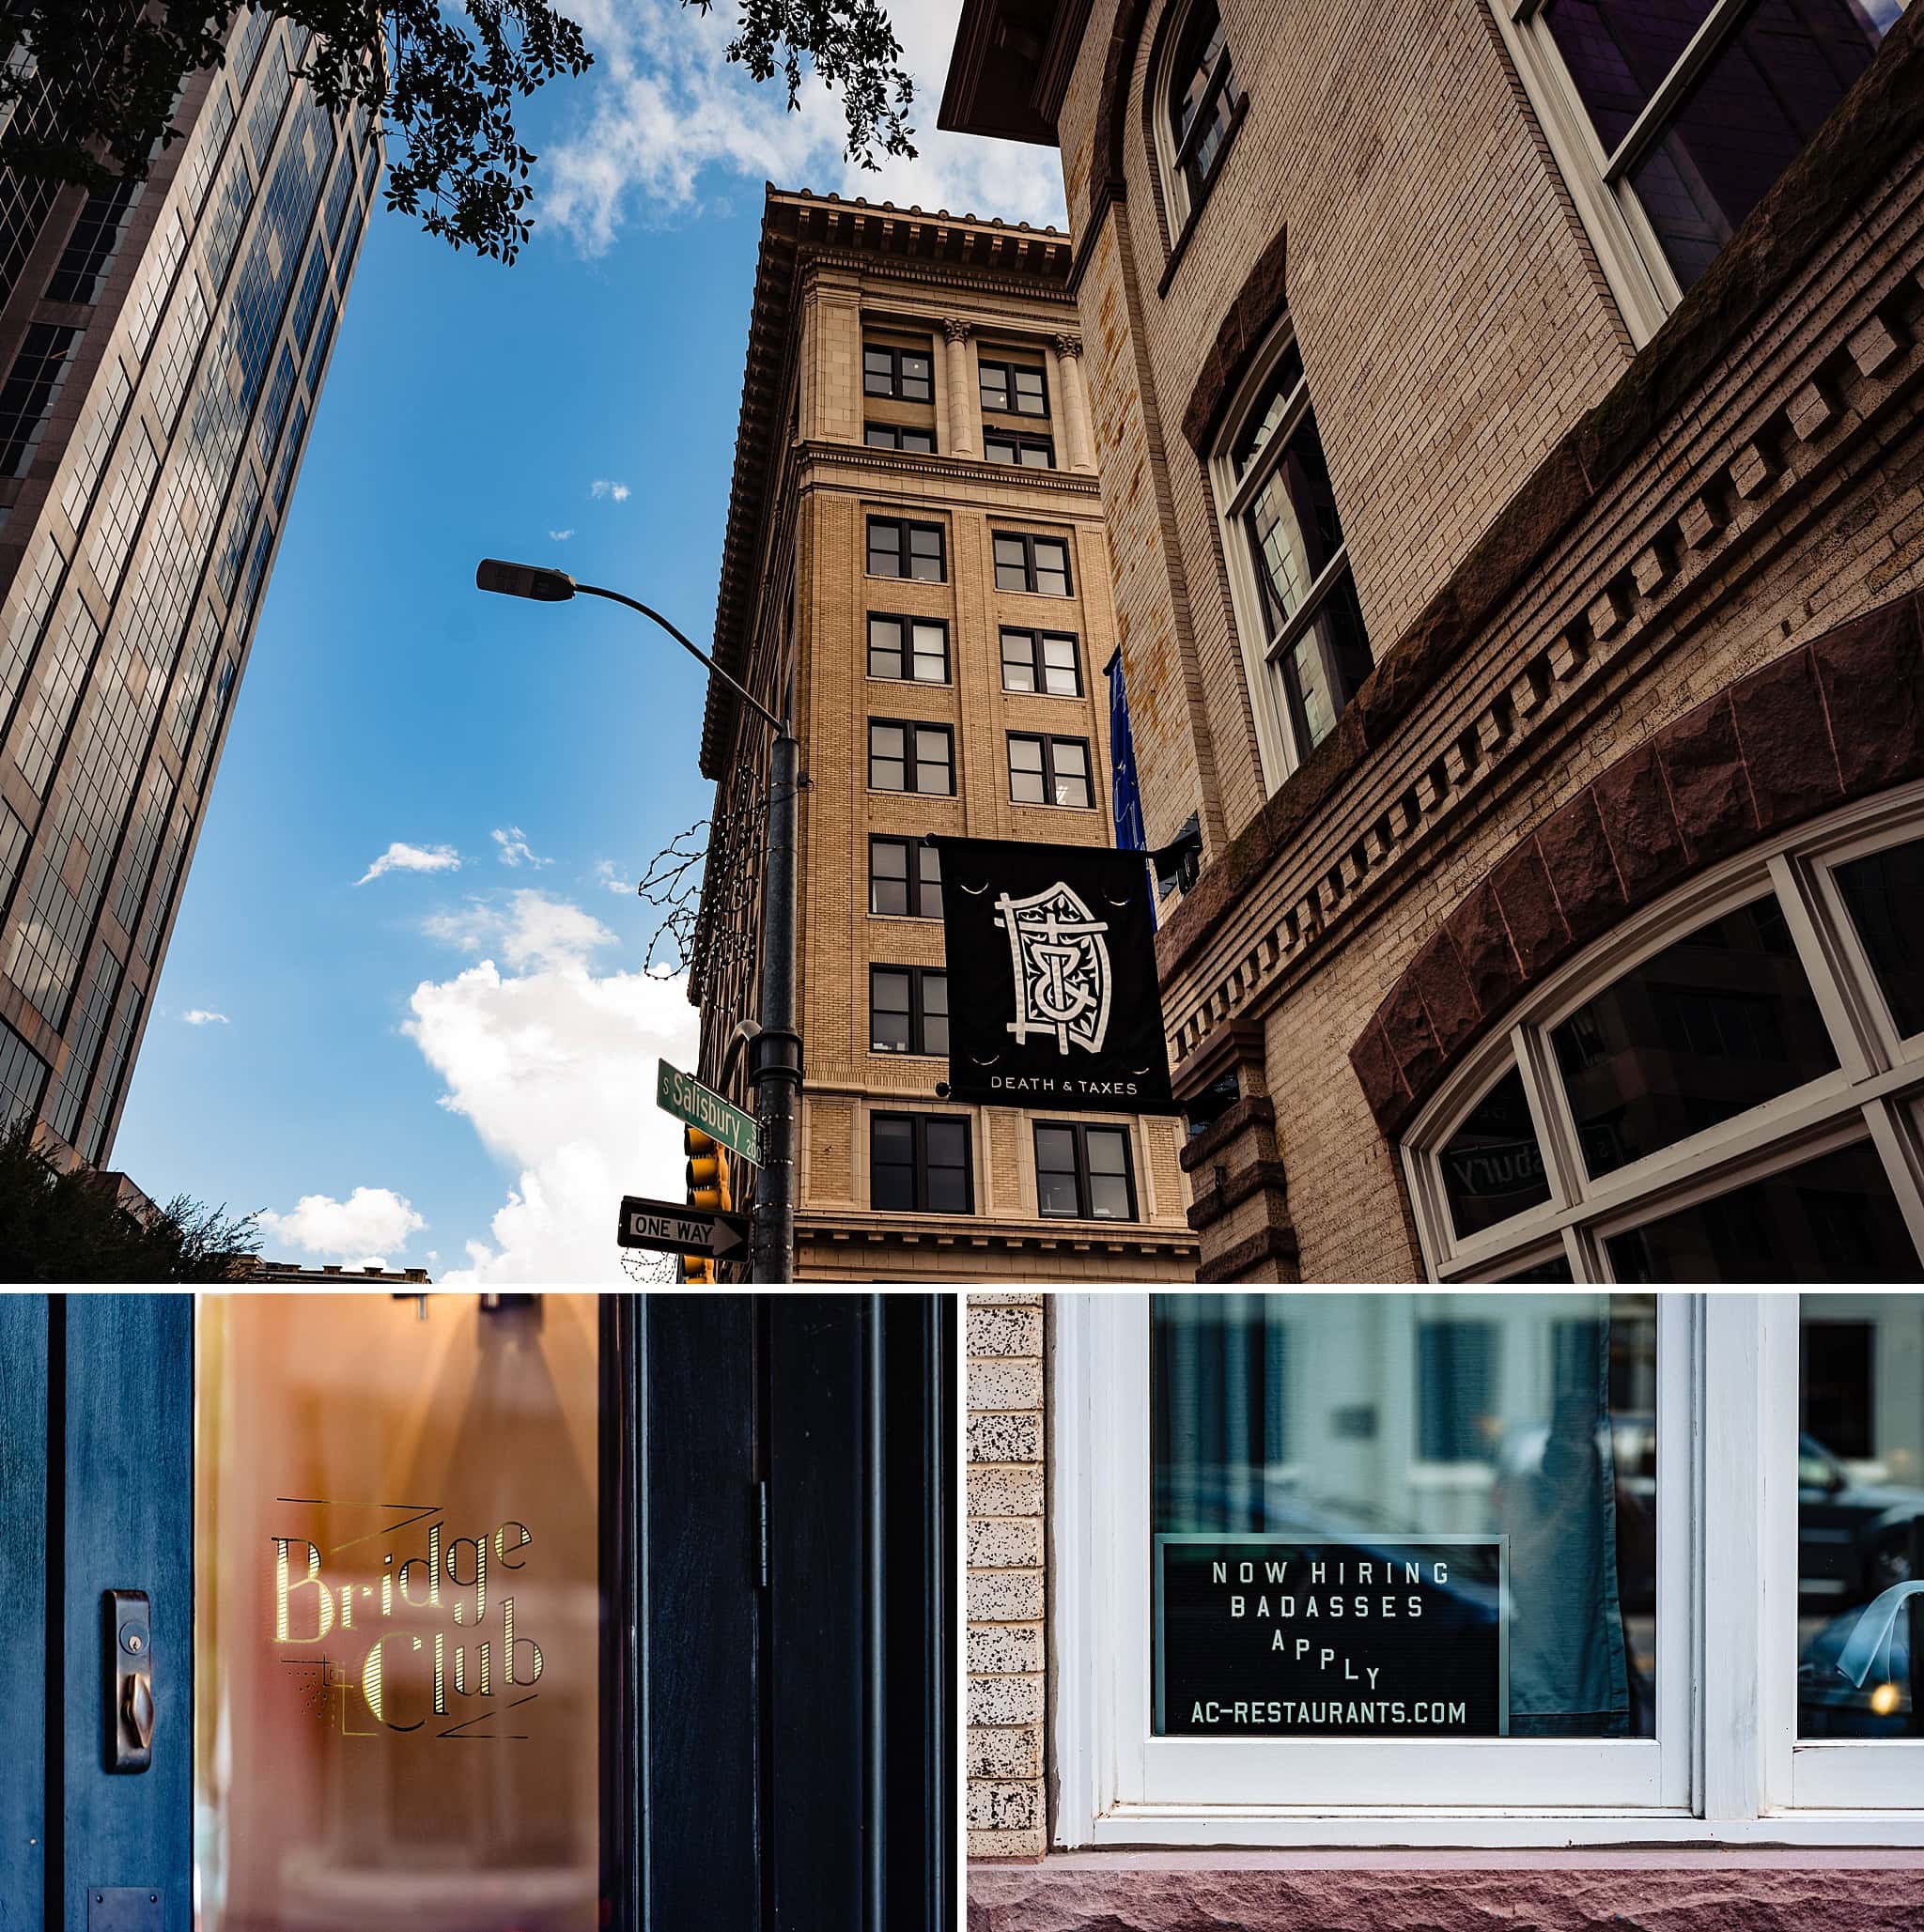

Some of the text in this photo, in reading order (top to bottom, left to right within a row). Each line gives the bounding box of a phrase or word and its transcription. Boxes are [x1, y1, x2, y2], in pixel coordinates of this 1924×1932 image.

[991, 1076, 1138, 1095] DEATH & TAXES
[662, 1077, 670, 1096] S
[673, 1074, 740, 1149] Salisbury
[635, 1215, 714, 1243] ONE WAY
[271, 1521, 533, 1644] Bridge
[1212, 1562, 1449, 1585] NOW HIRING
[1231, 1596, 1422, 1618] BADASSES
[362, 1596, 545, 1732] Club
[1271, 1629, 1380, 1691] APPLY
[1190, 1701, 1466, 1725] AC-RESTAURANTS.COM
